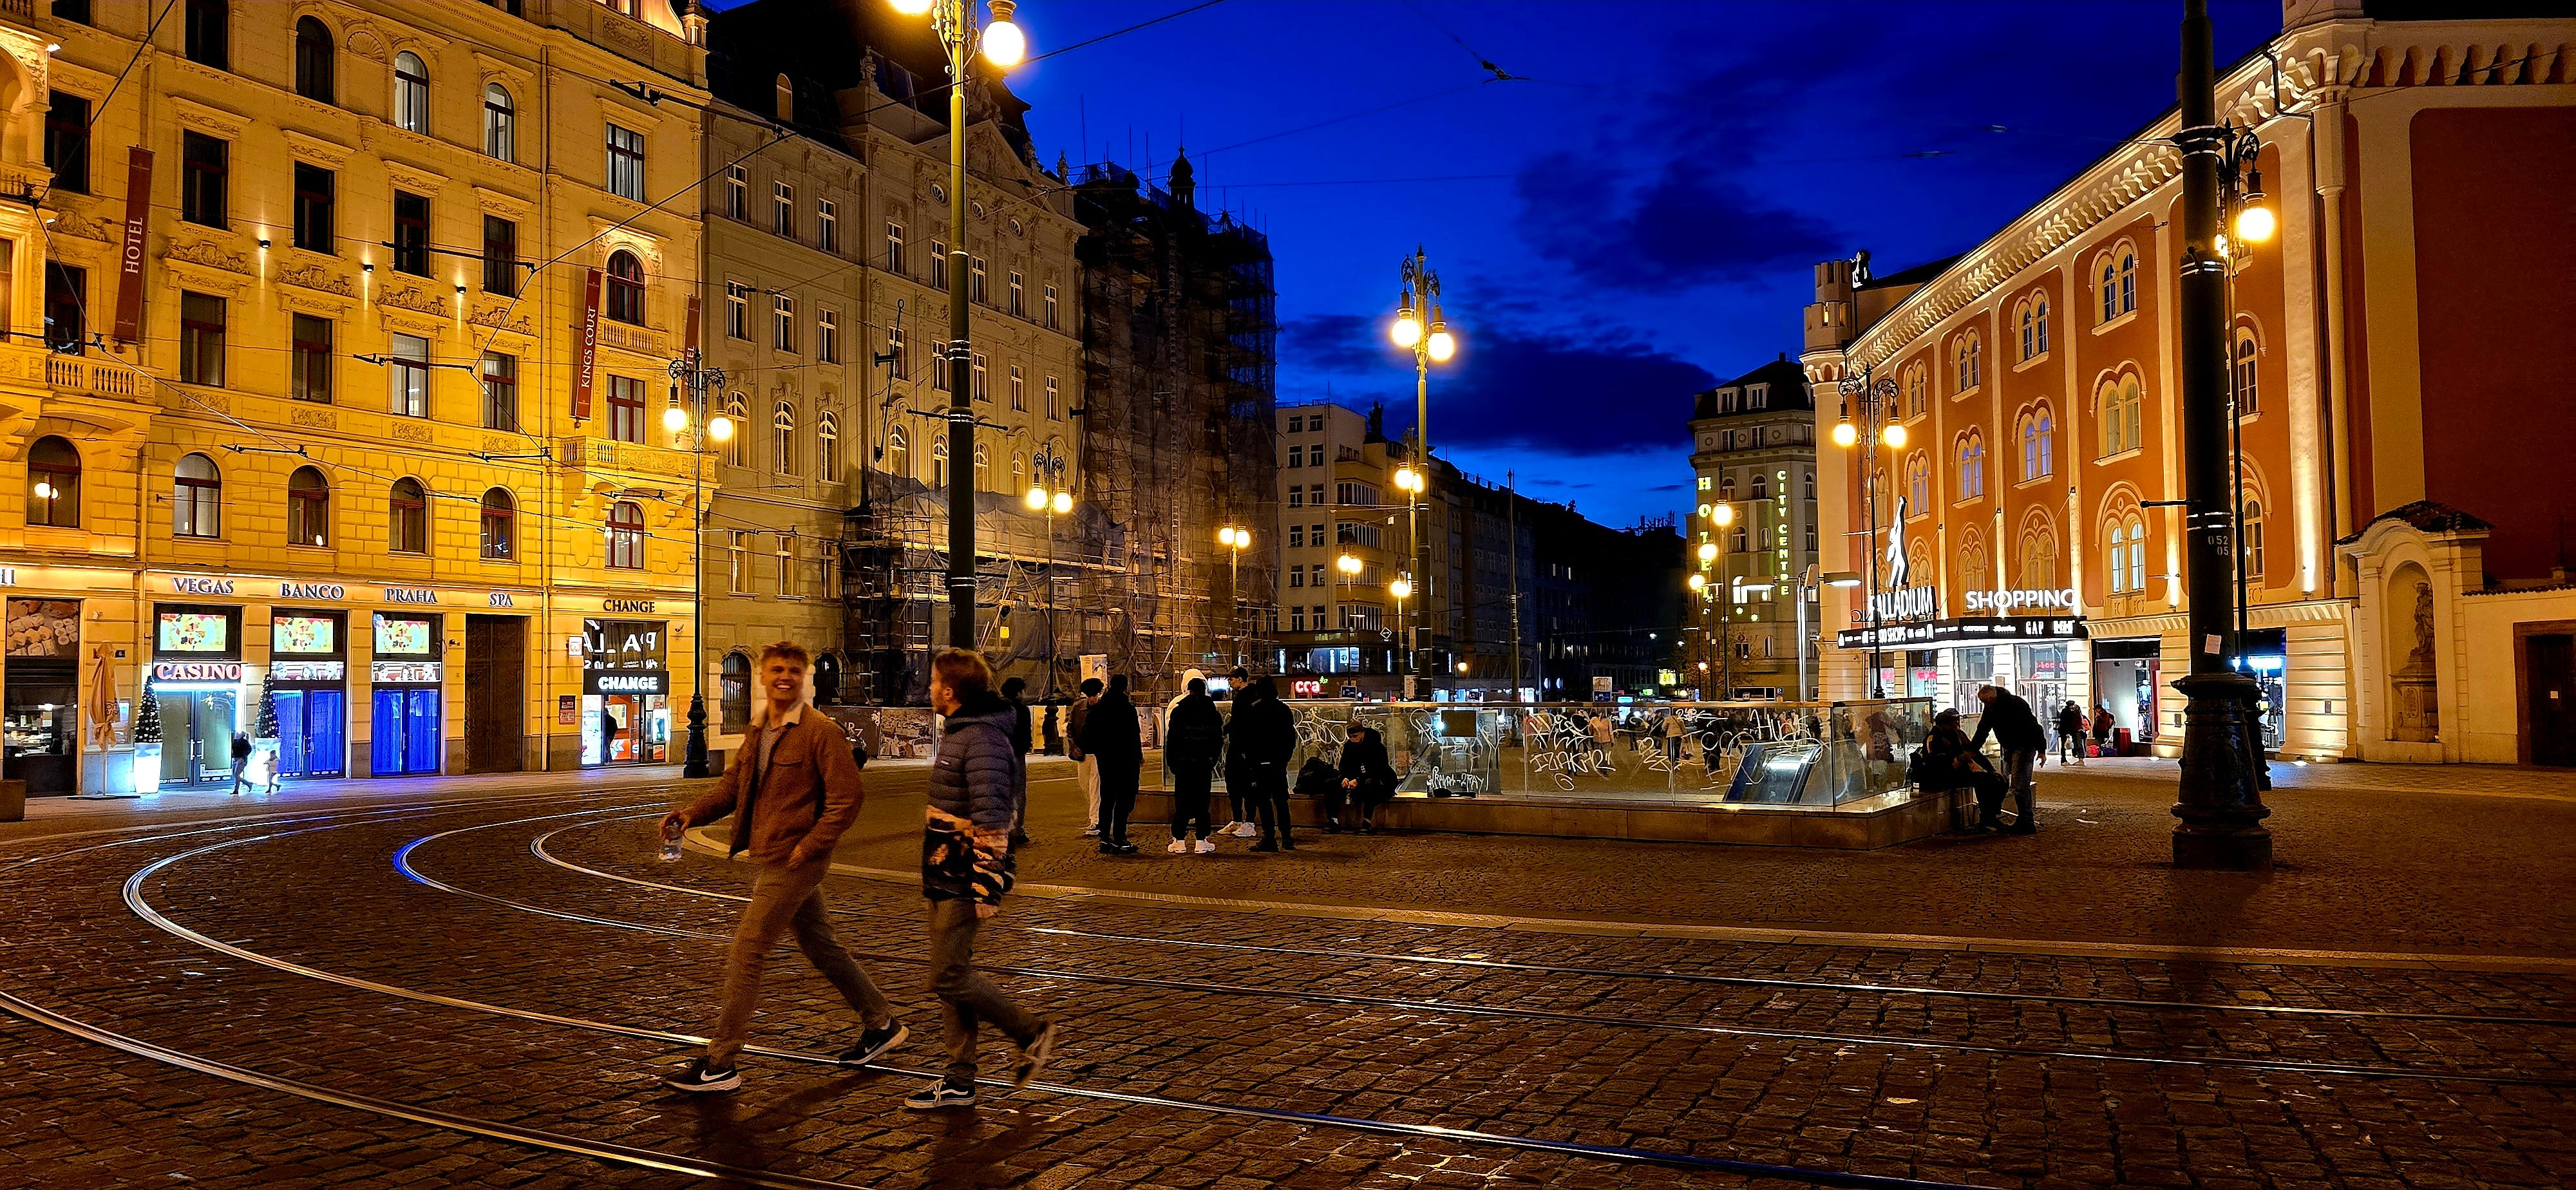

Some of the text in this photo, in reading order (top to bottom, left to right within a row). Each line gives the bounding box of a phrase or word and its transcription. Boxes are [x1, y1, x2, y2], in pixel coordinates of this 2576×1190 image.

[126, 217, 143, 274] HOTEL
[585, 305, 596, 346] COURT
[581, 348, 592, 388] KINGS
[1698, 477, 1712, 599] HOTEL
[1777, 469, 1789, 596] CITY CENTRE
[2208, 535, 2228, 545] 052
[2217, 546, 2229, 556] 05
[173, 577, 514, 607] VEGAS BANCO PRAHA SPA
[1965, 588, 2075, 609] SHOPPING
[603, 599, 656, 612] CHANGE
[2025, 621, 2044, 635] GAP
[156, 664, 242, 681] CASINO
[598, 676, 658, 690] CHANGE
